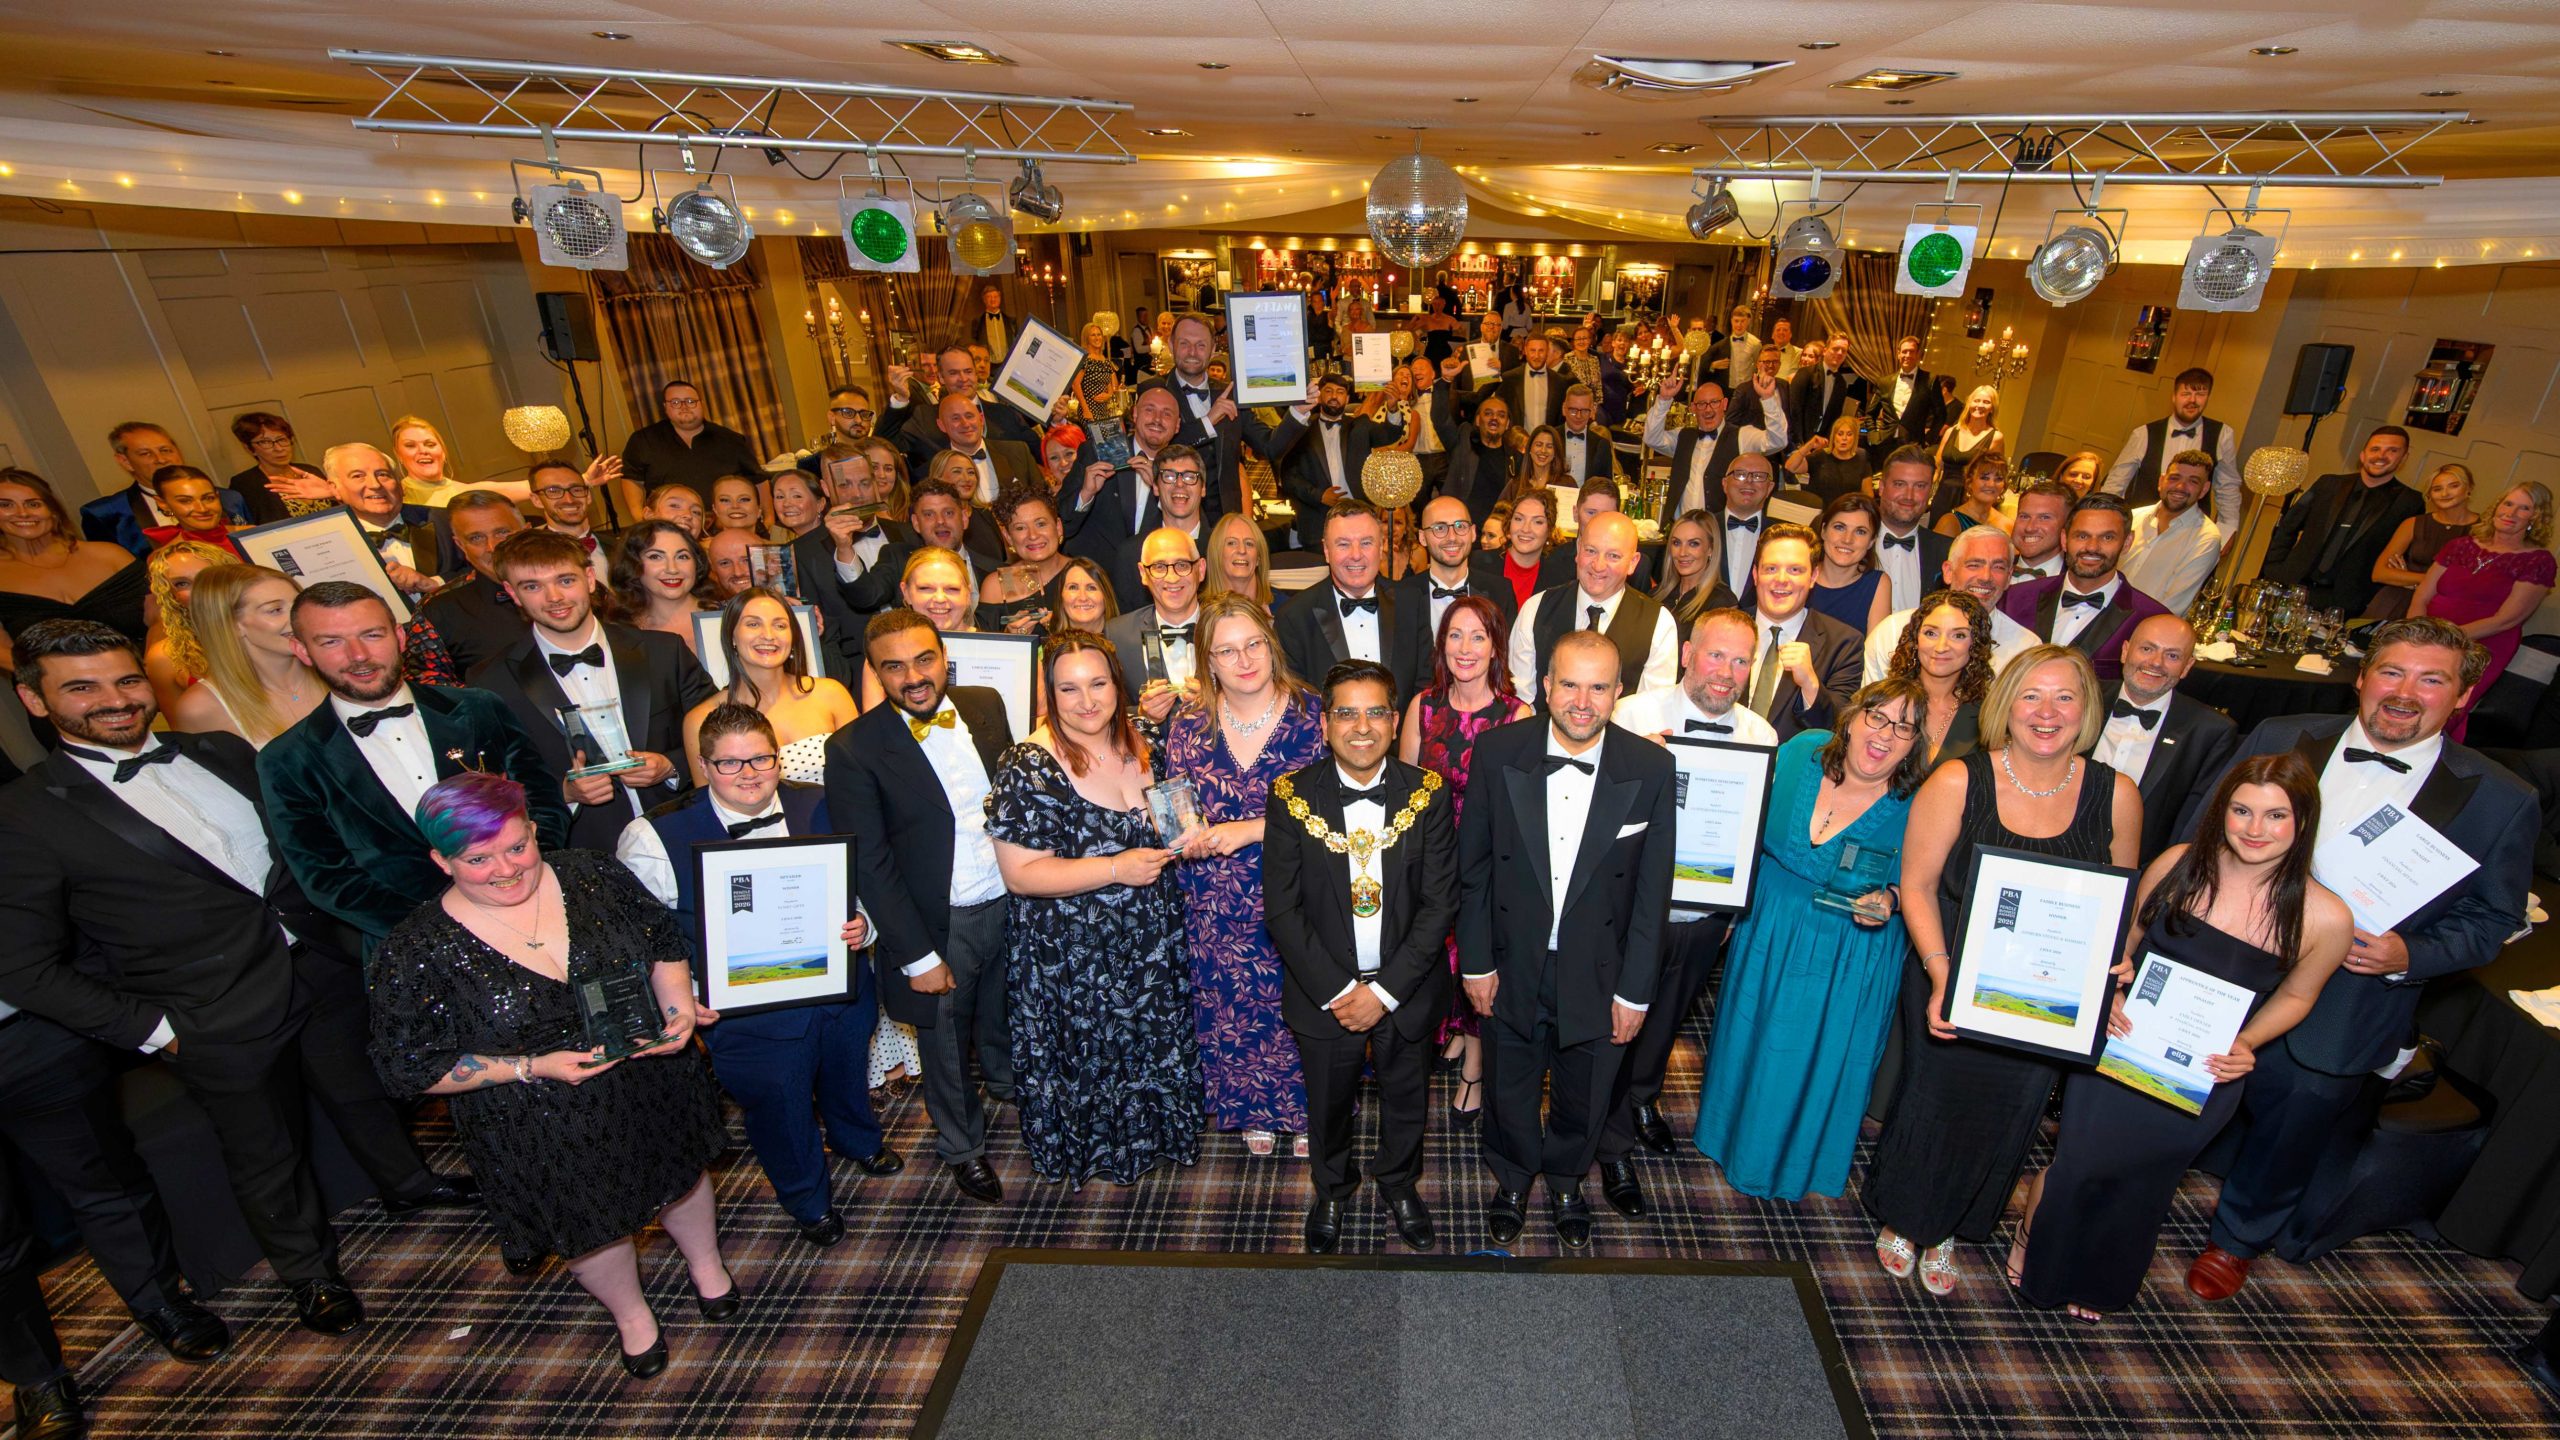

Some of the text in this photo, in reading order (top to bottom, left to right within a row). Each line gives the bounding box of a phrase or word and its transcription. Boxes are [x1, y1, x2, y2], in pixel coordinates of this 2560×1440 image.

[2383, 807, 2400, 821] PBA
[2358, 827, 2374, 840] 2026
[2430, 844, 2450, 861] BUSINESS
[2002, 890, 2019, 899] PBA
[1997, 918, 2014, 926] 2026
[2152, 963, 2169, 975] PBA
[2141, 989, 2157, 1000] 2026
